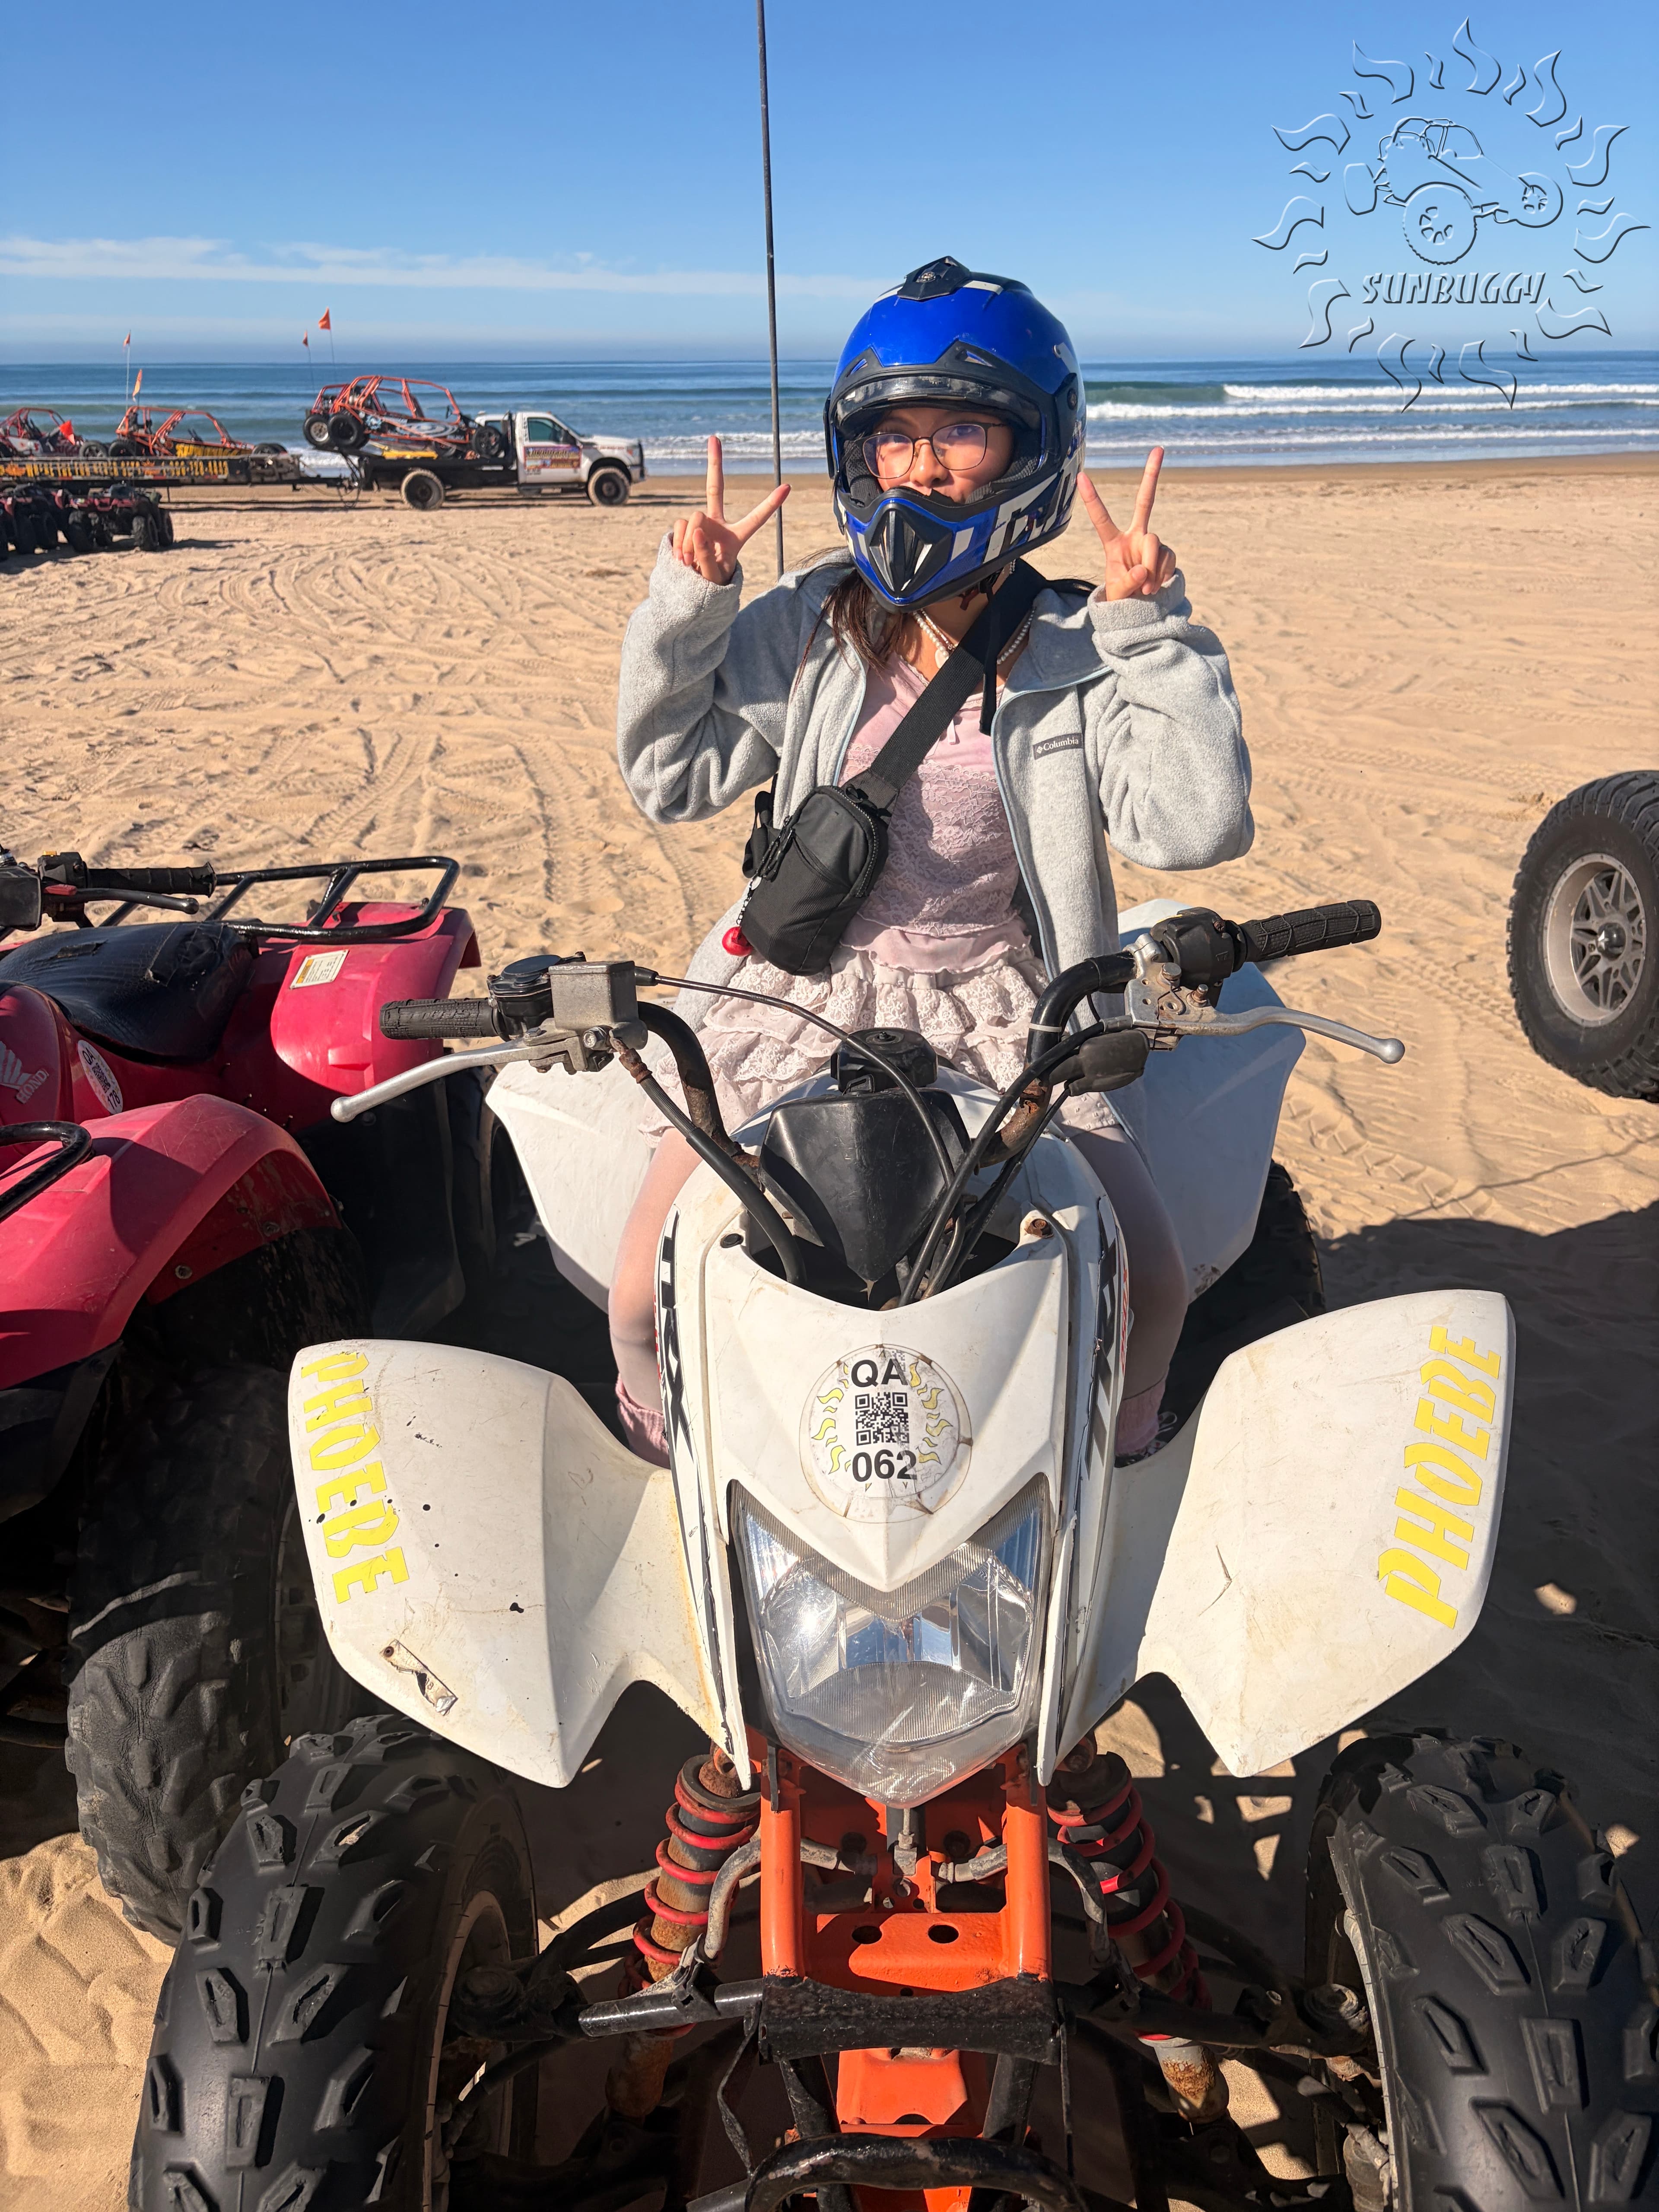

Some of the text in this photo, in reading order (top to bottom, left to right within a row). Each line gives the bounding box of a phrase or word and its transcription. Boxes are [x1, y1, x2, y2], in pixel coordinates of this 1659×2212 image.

[1043, 737, 1079, 751] Columbia
[82, 1047, 96, 1065] QA
[107, 1090, 121, 1110] 178
[661, 1210, 695, 1464] TRX
[851, 1358, 909, 1387] QA
[301, 1351, 410, 1604] PHOEBE
[852, 1449, 917, 1482] 062
[1378, 1325, 1501, 1629] PHOEBE
